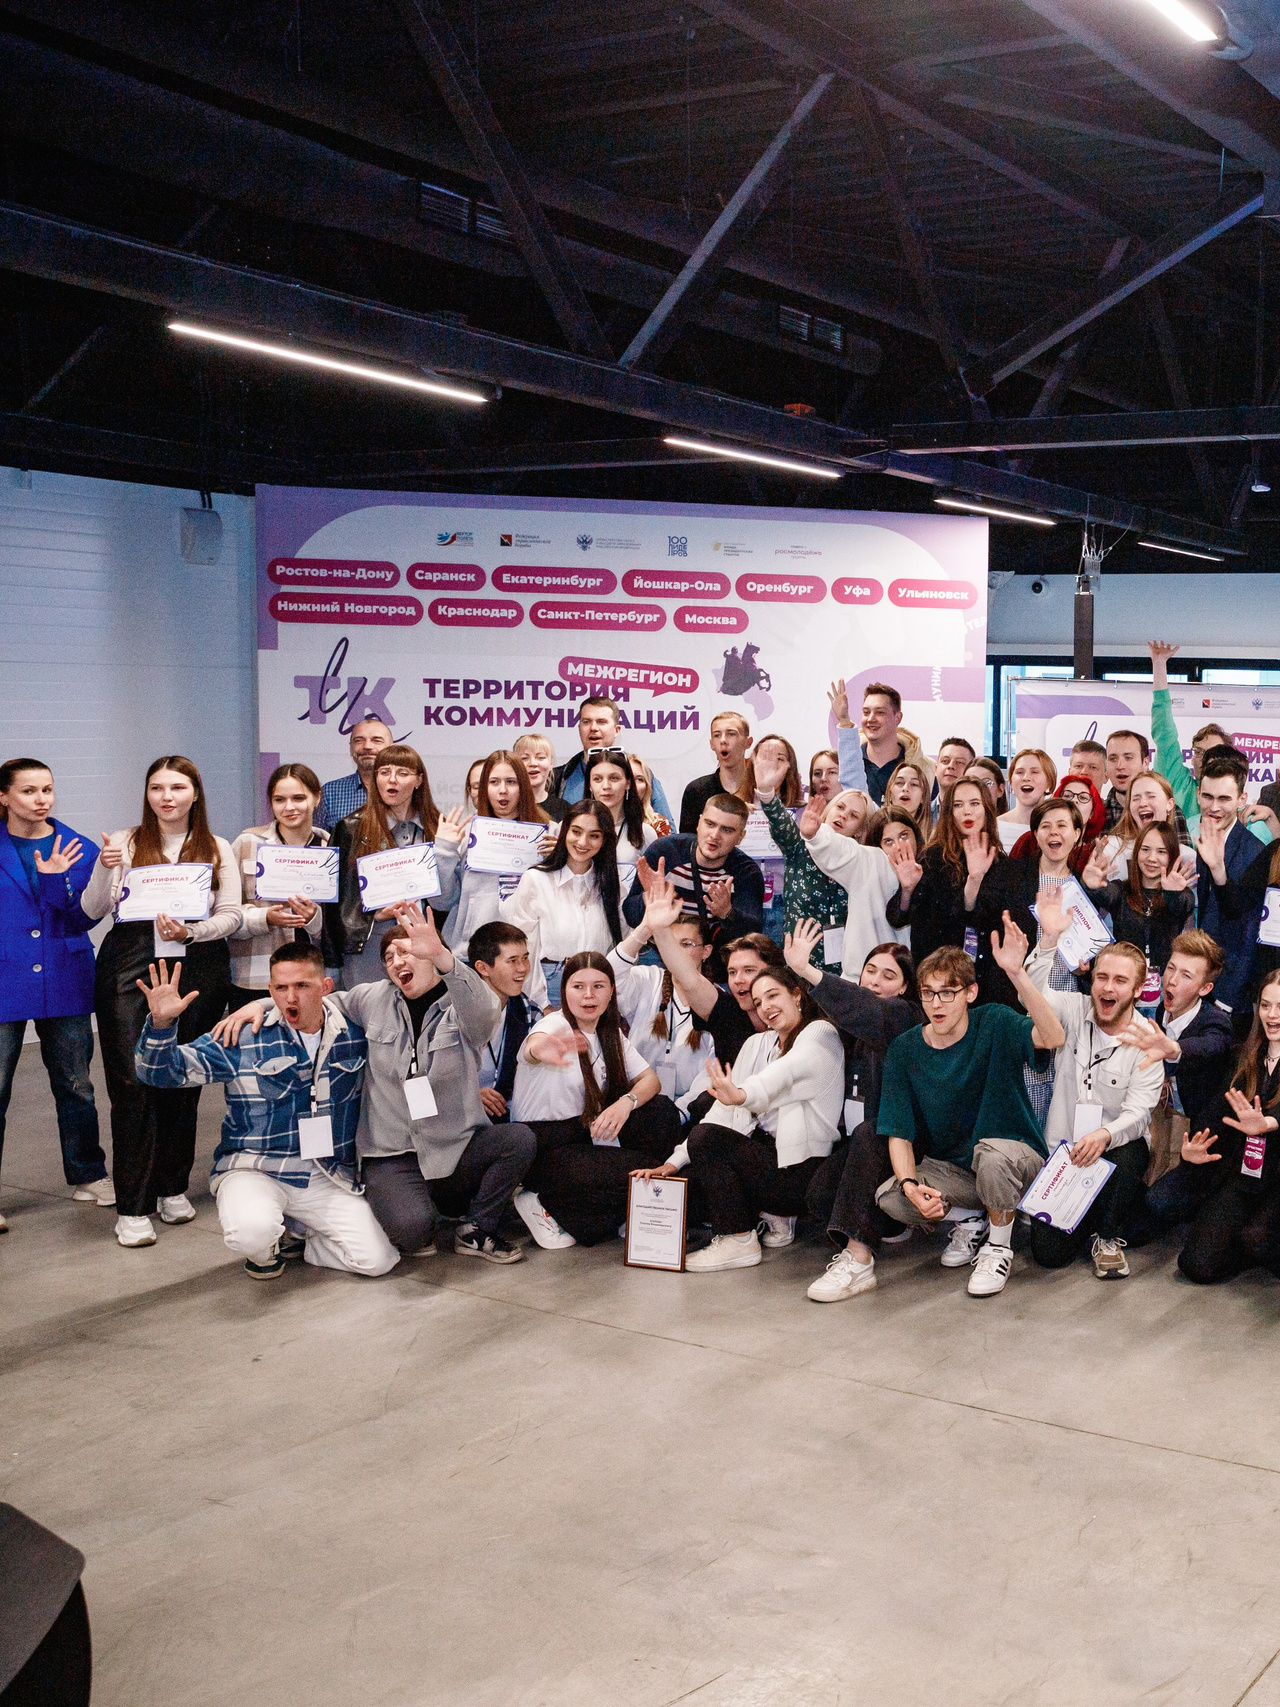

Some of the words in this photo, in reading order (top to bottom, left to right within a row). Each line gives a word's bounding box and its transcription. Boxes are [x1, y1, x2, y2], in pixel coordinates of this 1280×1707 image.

[276, 564, 394, 580] Ростов-на-Дону
[414, 569, 476, 583] Саранск
[502, 573, 603, 588] Екатеринбург
[633, 576, 721, 592] Йошкар-Ола
[746, 581, 814, 595] Оренбург
[844, 585, 871, 598] Уфа
[898, 587, 969, 601] Ульяновск
[277, 600, 340, 613] Нижний
[344, 603, 416, 617] Новгород
[437, 605, 518, 619] Краснодар
[537, 608, 660, 625] Санкт-Петербург
[685, 614, 738, 626] Москва
[567, 662, 692, 687] МЕЖРЕГИОН
[423, 678, 630, 702] ТЕРРИТОРИЯ
[423, 705, 700, 734] КОММУНИАЦИЙ
[488, 830, 529, 840] СЕРТИФИКАТ
[374, 858, 416, 871] СЕРТИФИКАТ
[141, 876, 189, 884] СЕРТИФИКАТ
[1072, 904, 1092, 931] ДИПЛОМ
[1041, 1161, 1069, 1200] СЕРТИФИКАТ
